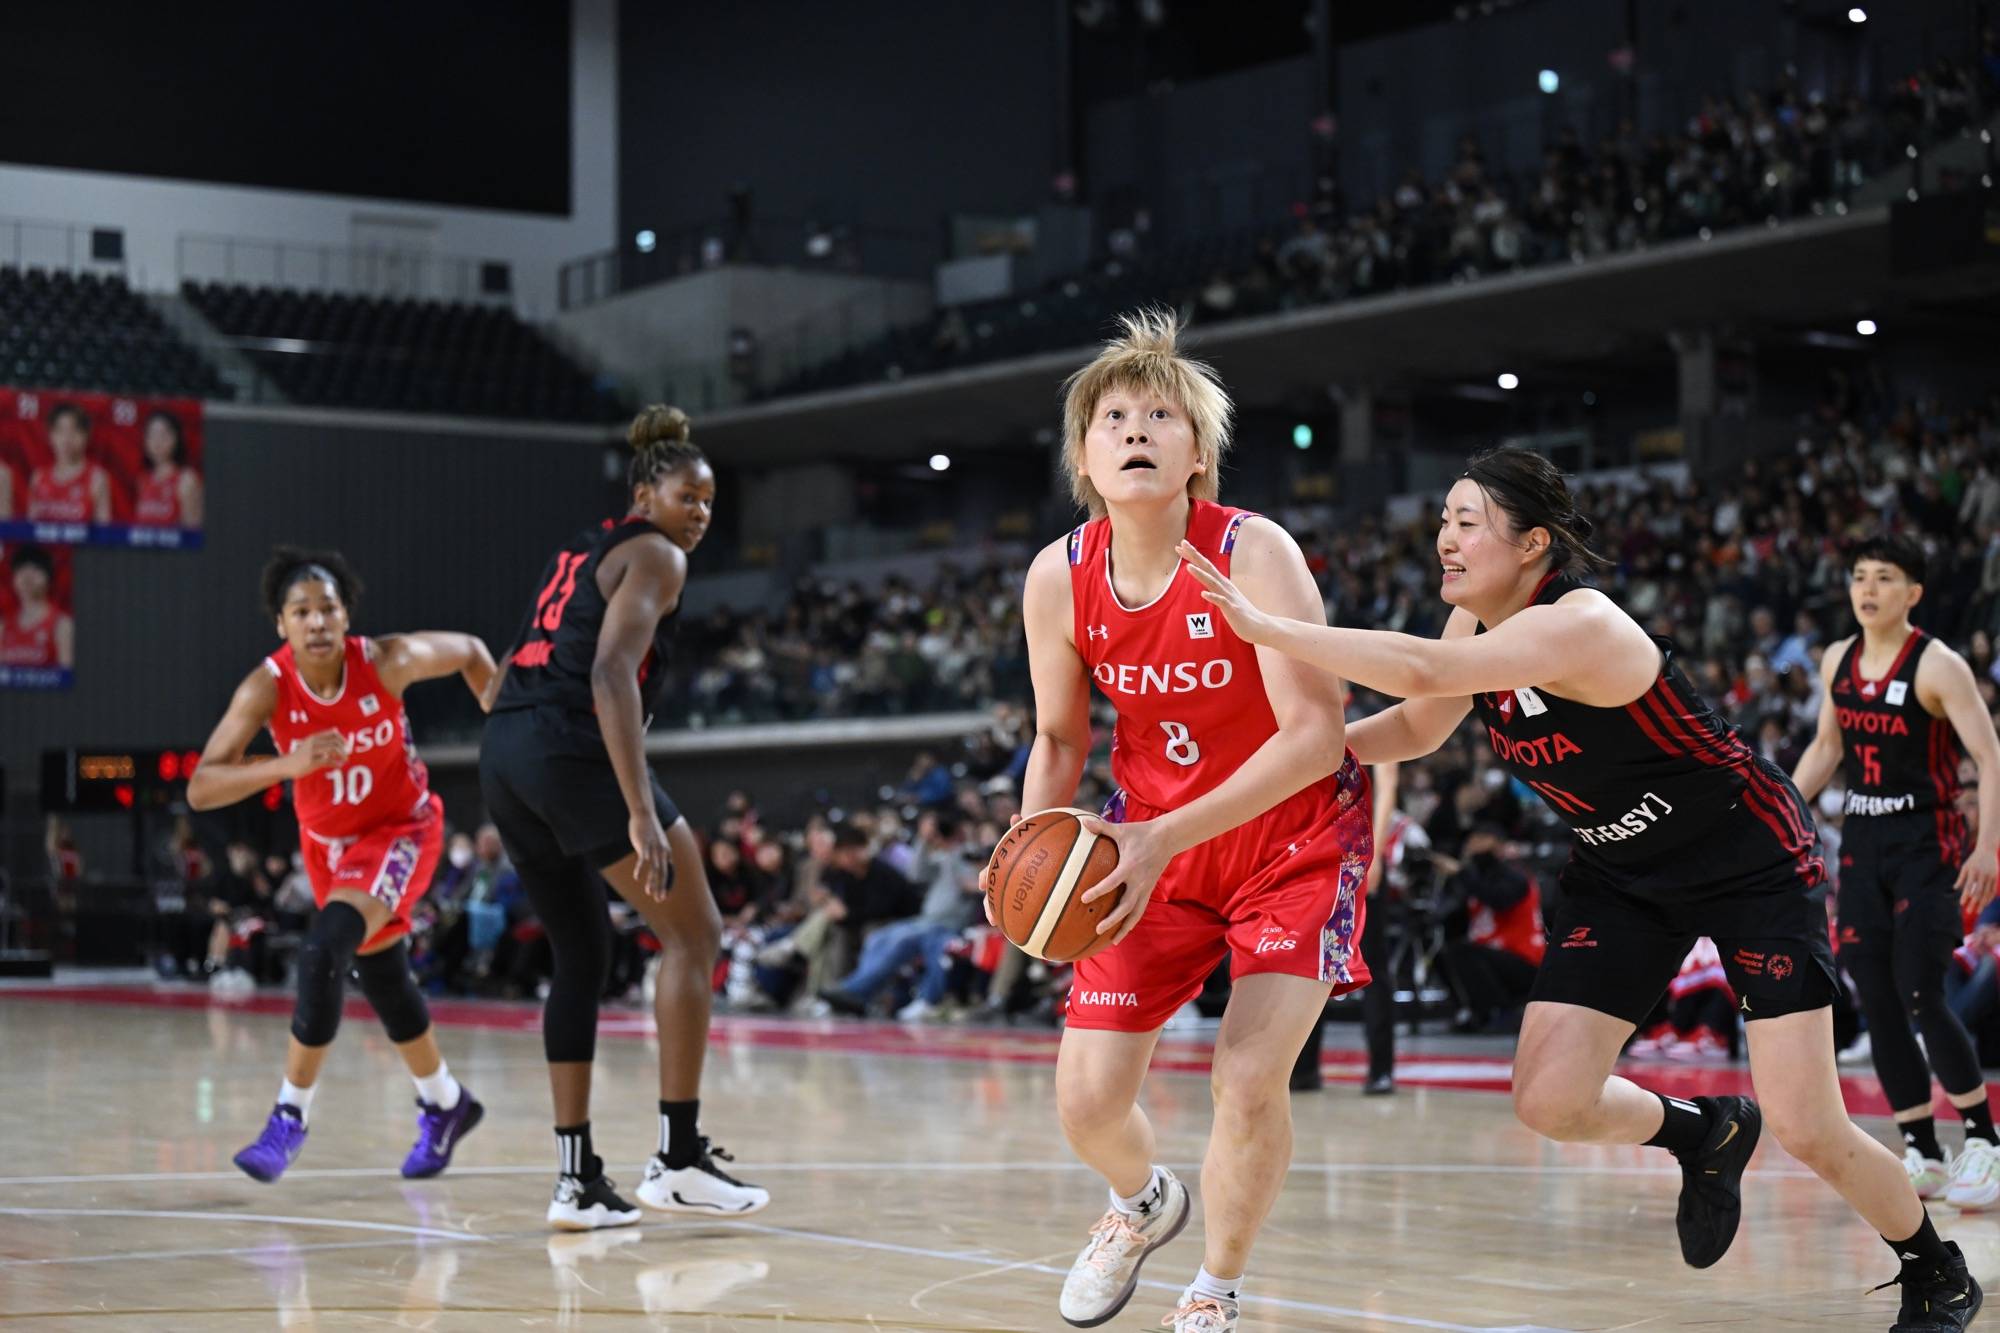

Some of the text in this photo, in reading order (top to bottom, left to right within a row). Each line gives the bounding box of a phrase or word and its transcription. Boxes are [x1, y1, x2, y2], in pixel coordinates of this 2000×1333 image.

[1093, 658, 1233, 695] DENSO
[1159, 721, 1200, 766] 8
[1489, 725, 1584, 768] TOYOTA
[325, 765, 373, 806] 10
[1012, 847, 1049, 912] molten
[1079, 989, 1139, 1007] KARIYA
